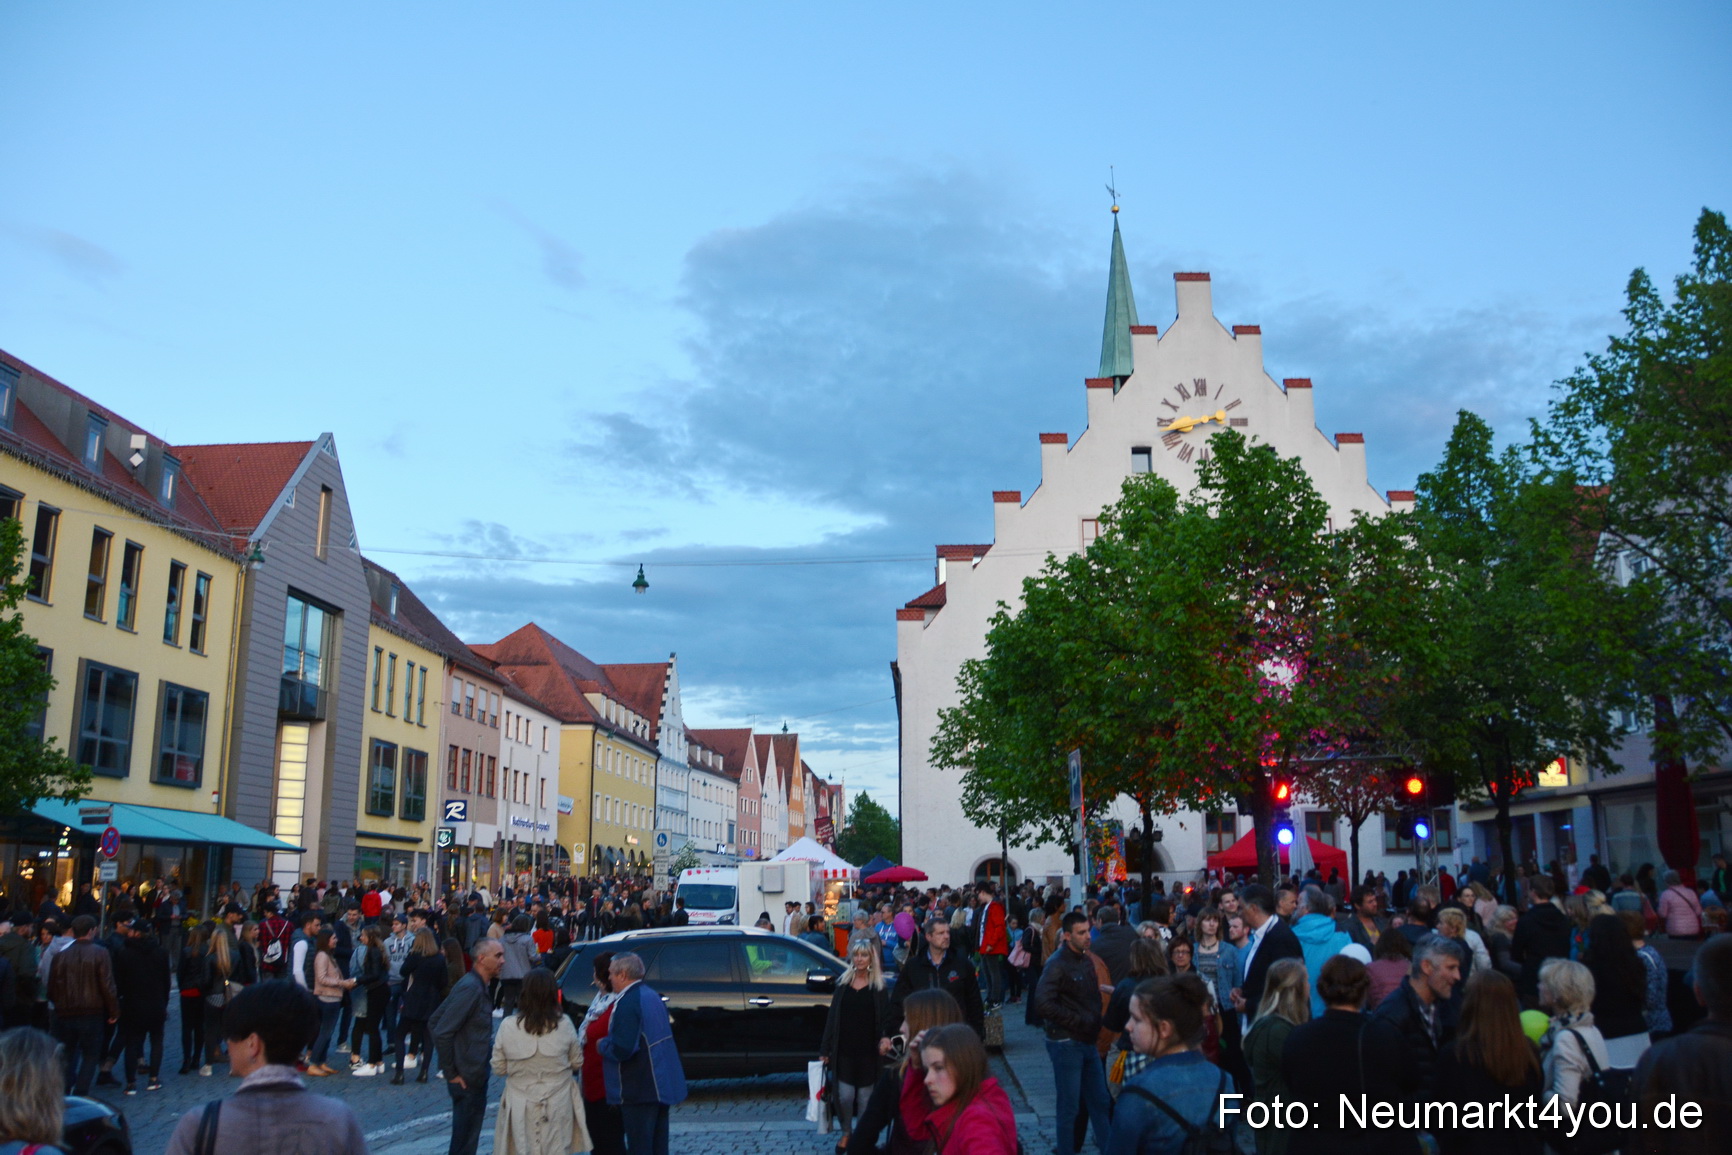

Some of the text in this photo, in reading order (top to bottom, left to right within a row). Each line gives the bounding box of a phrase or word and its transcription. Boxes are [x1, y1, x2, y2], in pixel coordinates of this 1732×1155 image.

[1174, 382, 1192, 402] XI
[1193, 378, 1207, 397] XII
[1160, 398, 1180, 413] X
[1224, 398, 1242, 411] II
